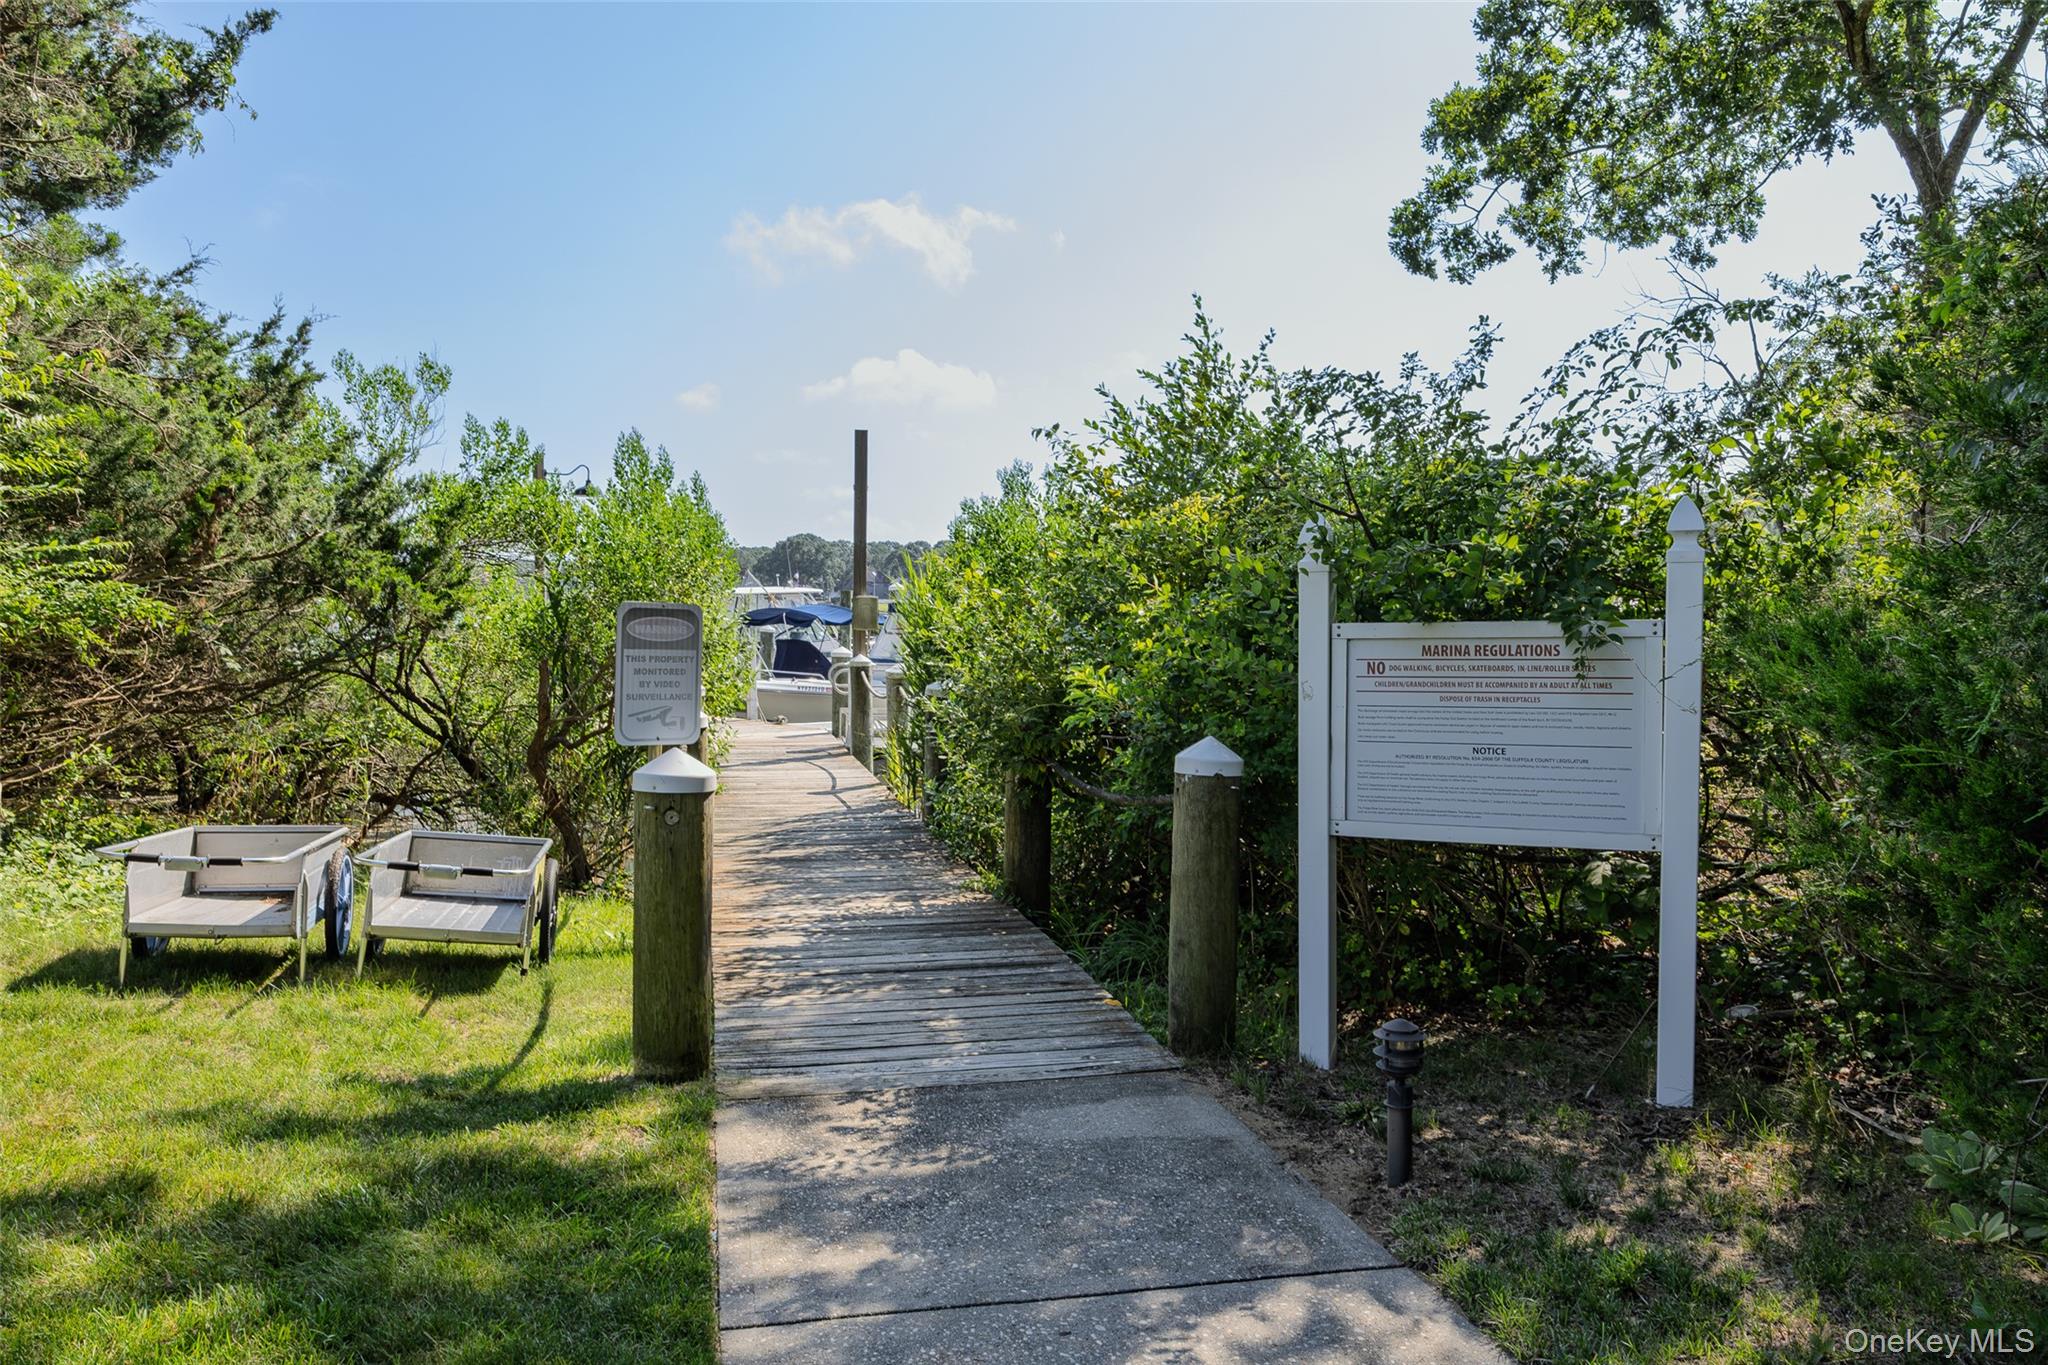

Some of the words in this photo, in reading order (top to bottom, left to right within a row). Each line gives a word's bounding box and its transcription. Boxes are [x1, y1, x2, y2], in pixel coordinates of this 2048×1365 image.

[1421, 644, 1471, 657] MARINA
[1474, 644, 1561, 657] REGULATIONS
[625, 655, 647, 664] THIS
[648, 655, 695, 664] PROPERTY
[633, 667, 687, 676] MONITORED
[1367, 661, 1386, 675] NO
[1389, 664, 1402, 672] DOG
[1403, 664, 1434, 673] WALKING,
[1435, 664, 1466, 673] BICYCLES,
[639, 680, 651, 688] BY
[654, 680, 681, 689] VIDEO
[1374, 680, 1456, 688] CHILDREN/GRANDCHILDREN
[1457, 681, 1474, 689] MUST
[1475, 681, 1483, 689] BE
[1484, 681, 1529, 689] ACCOMPANIED
[1580, 682, 1591, 690] ALL
[1593, 682, 1613, 690] TIMES
[625, 693, 693, 701] SURVEILLANCE
[1439, 695, 1464, 703] DISPOSE
[1494, 696, 1500, 704] IN
[1501, 696, 1541, 704] RECEPTACLES
[1472, 747, 1507, 756] NOTICE
